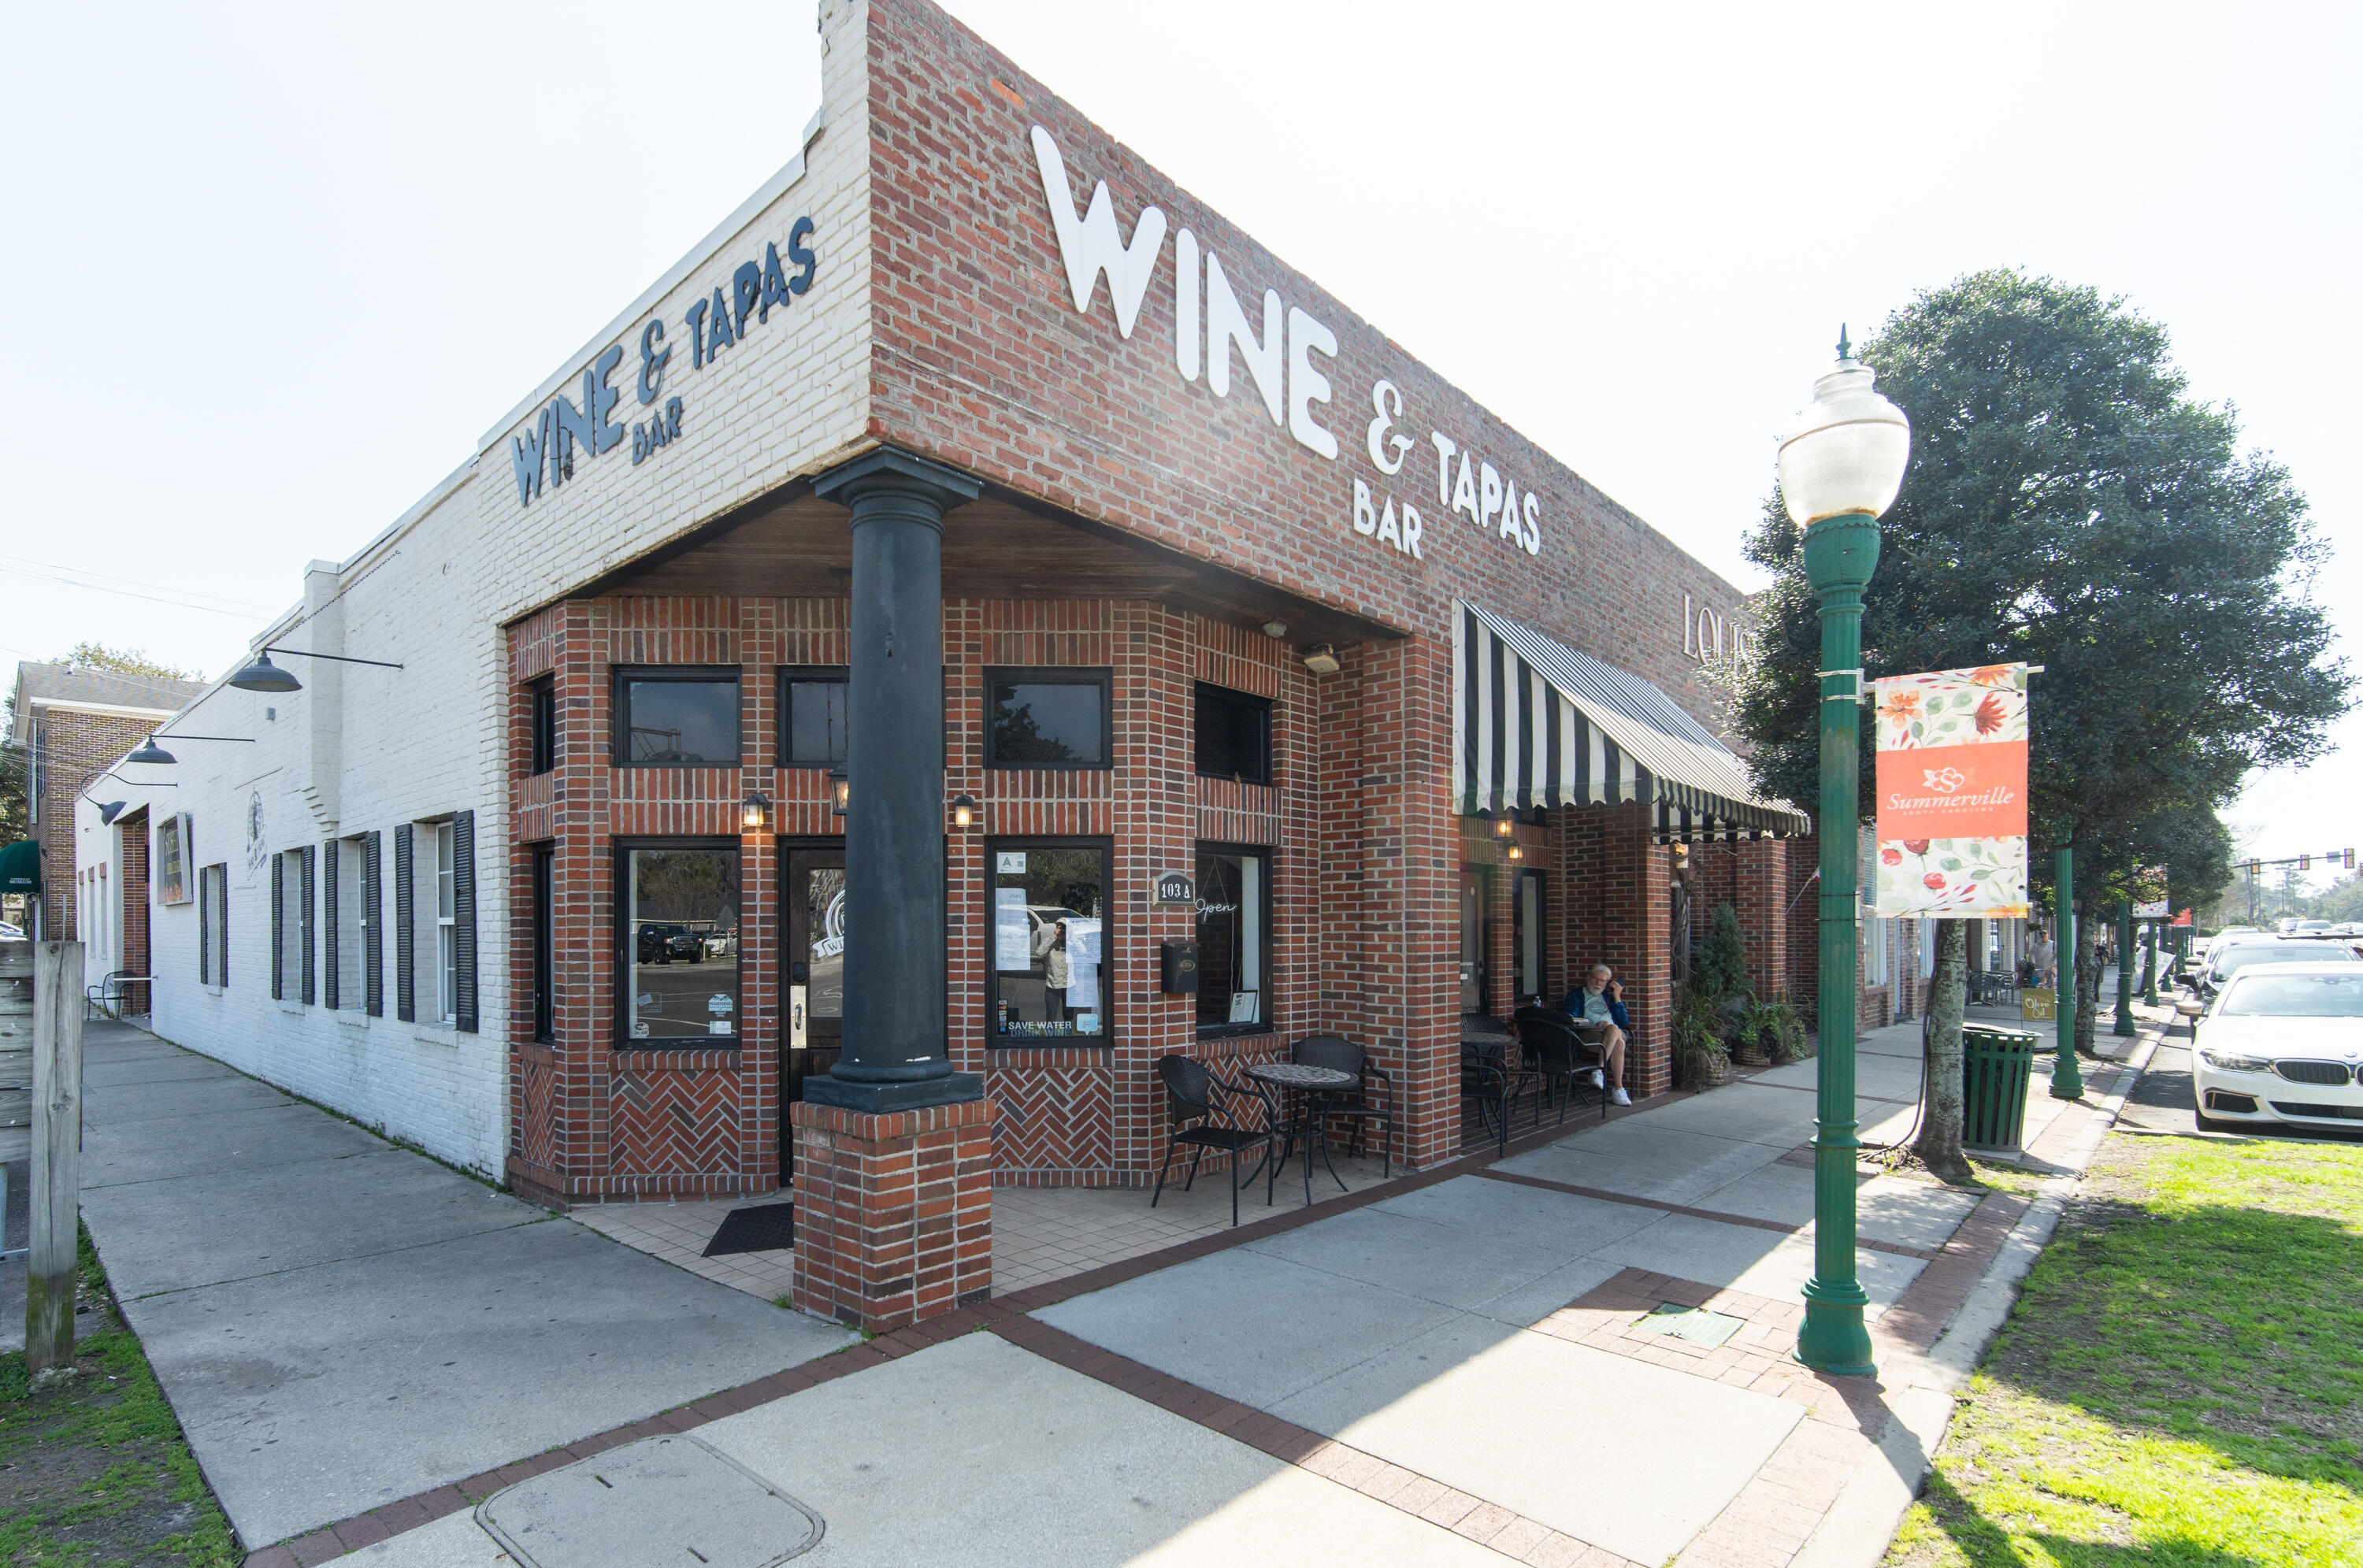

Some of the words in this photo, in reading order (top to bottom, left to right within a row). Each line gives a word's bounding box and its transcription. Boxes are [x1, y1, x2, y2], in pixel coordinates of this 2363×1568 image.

[1031, 124, 1337, 461] WINE
[1367, 379, 1415, 475] &
[1431, 431, 1541, 556] TAPAS
[511, 344, 624, 508] WINE
[637, 319, 672, 406] &
[685, 216, 816, 371] TAPAS
[632, 396, 682, 467] BAR
[1353, 478, 1423, 560] BAR
[1886, 786, 2015, 810] Summerville
[1002, 856, 1012, 866] A
[1161, 883, 1181, 898] 103
[1184, 884, 1190, 899] A
[1195, 898, 1237, 922] Open
[828, 939, 844, 951] WI
[2025, 997, 2050, 1009] Olive
[1008, 1021, 1034, 1030] SAVE
[1037, 1021, 1072, 1029] WATER
[1010, 1029, 1041, 1037] DRINK
